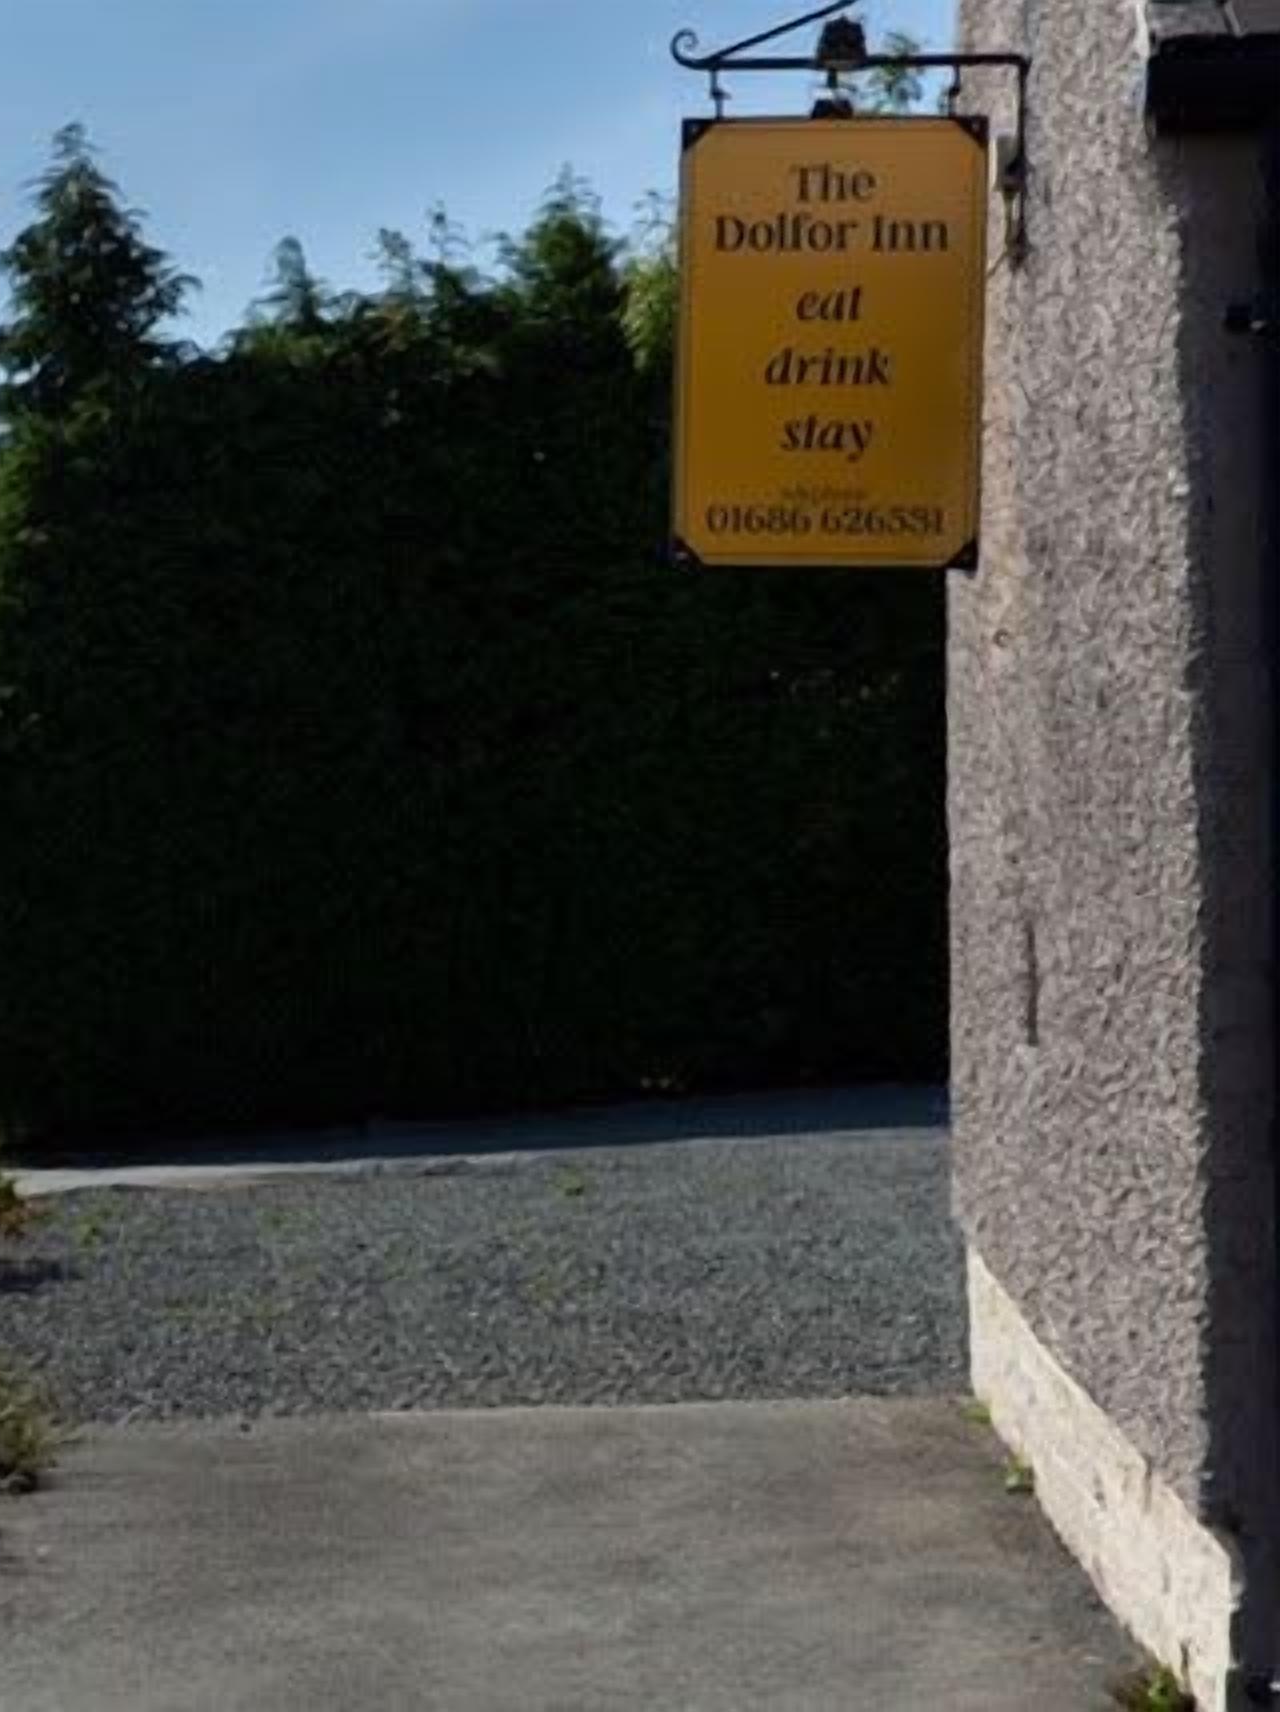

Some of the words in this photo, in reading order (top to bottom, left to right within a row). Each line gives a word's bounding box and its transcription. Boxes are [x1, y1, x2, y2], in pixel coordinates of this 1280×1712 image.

[792, 162, 876, 201] The
[715, 211, 859, 251] Dolfor
[872, 213, 949, 251] Inn
[796, 286, 862, 321] eat
[764, 347, 889, 385] drink
[781, 415, 873, 462] stay
[706, 504, 812, 536] 01686
